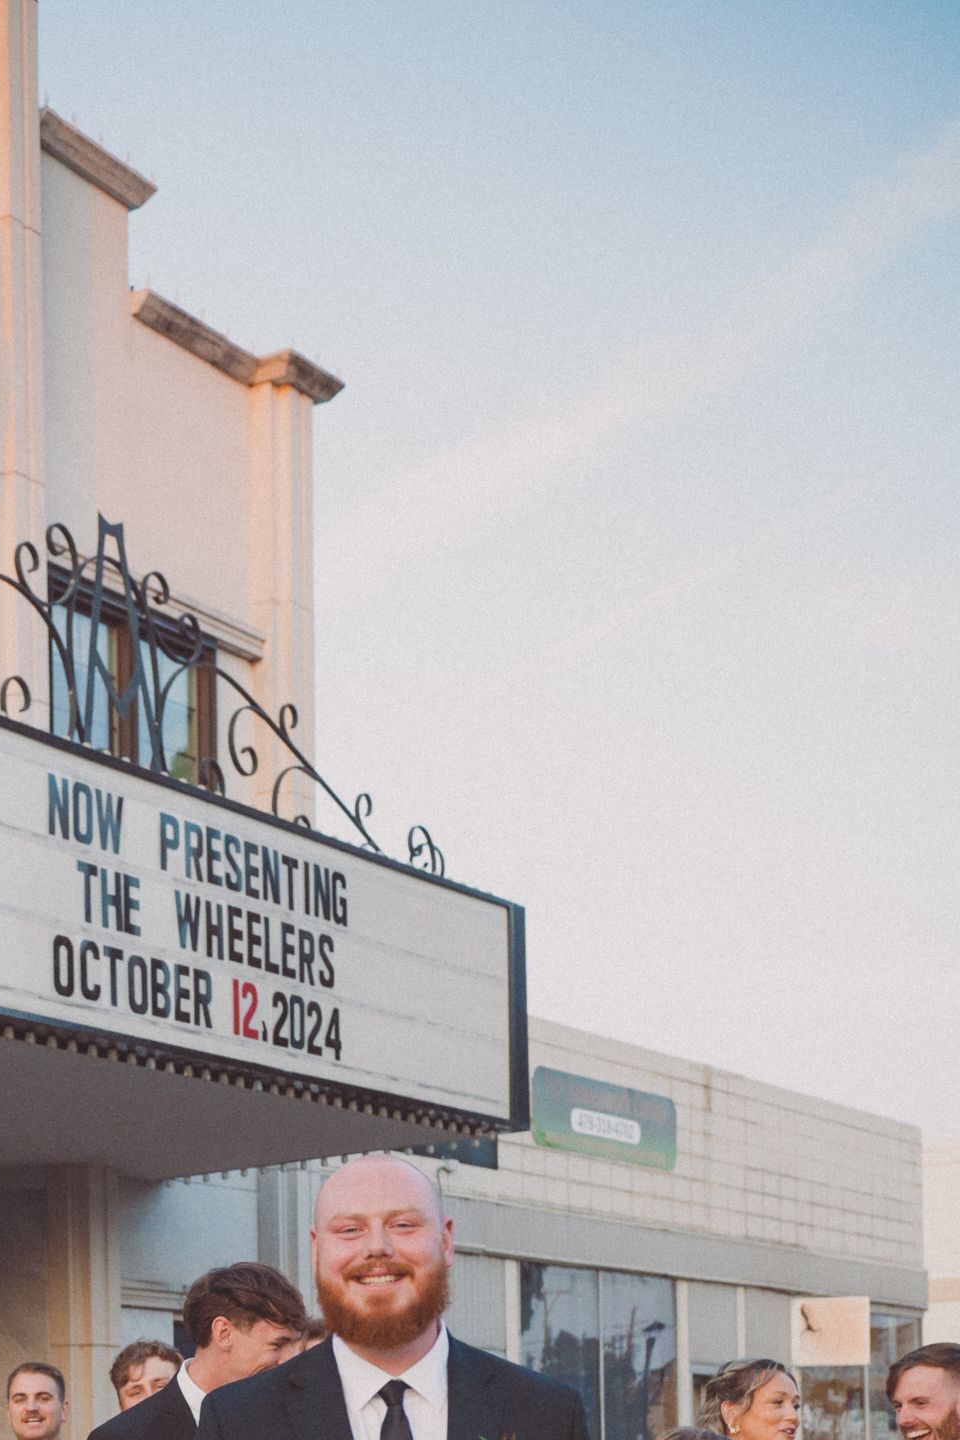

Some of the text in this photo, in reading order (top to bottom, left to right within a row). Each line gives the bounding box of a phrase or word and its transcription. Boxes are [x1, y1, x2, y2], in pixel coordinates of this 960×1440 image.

[47, 772, 348, 927] NOW PRESENTING
[52, 934, 213, 1029] OCTOBER
[76, 859, 335, 989] THE WHEELERS
